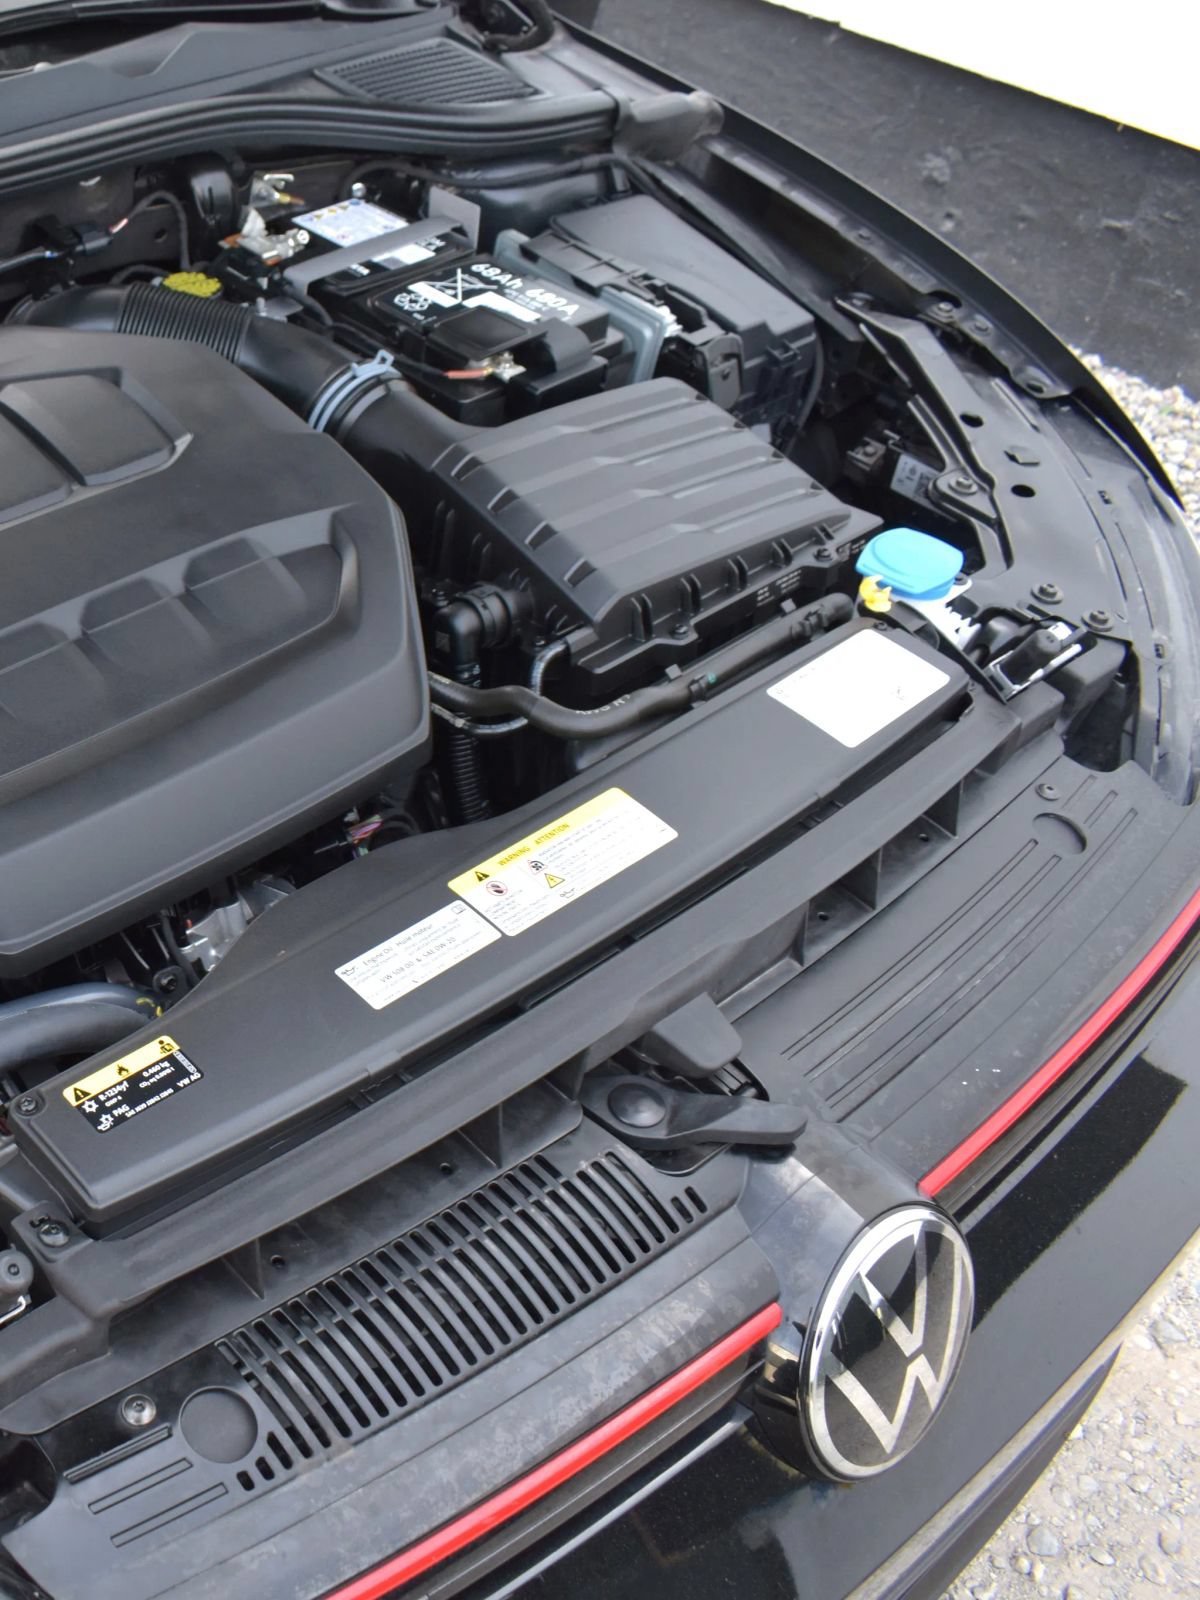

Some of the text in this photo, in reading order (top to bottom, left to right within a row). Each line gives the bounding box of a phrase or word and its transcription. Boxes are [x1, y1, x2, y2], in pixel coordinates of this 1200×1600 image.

[470, 263, 524, 290] 68Ah
[526, 288, 580, 318] 680A
[498, 823, 570, 866] WARNING ATTENTION
[362, 951, 384, 967] Engine
[160, 1060, 171, 1070] kg
[176, 1071, 202, 1088] VW AG
[98, 1080, 130, 1101] R-1234yf
[112, 1103, 130, 1117] PAG
[810, 1212, 970, 1475] VW
